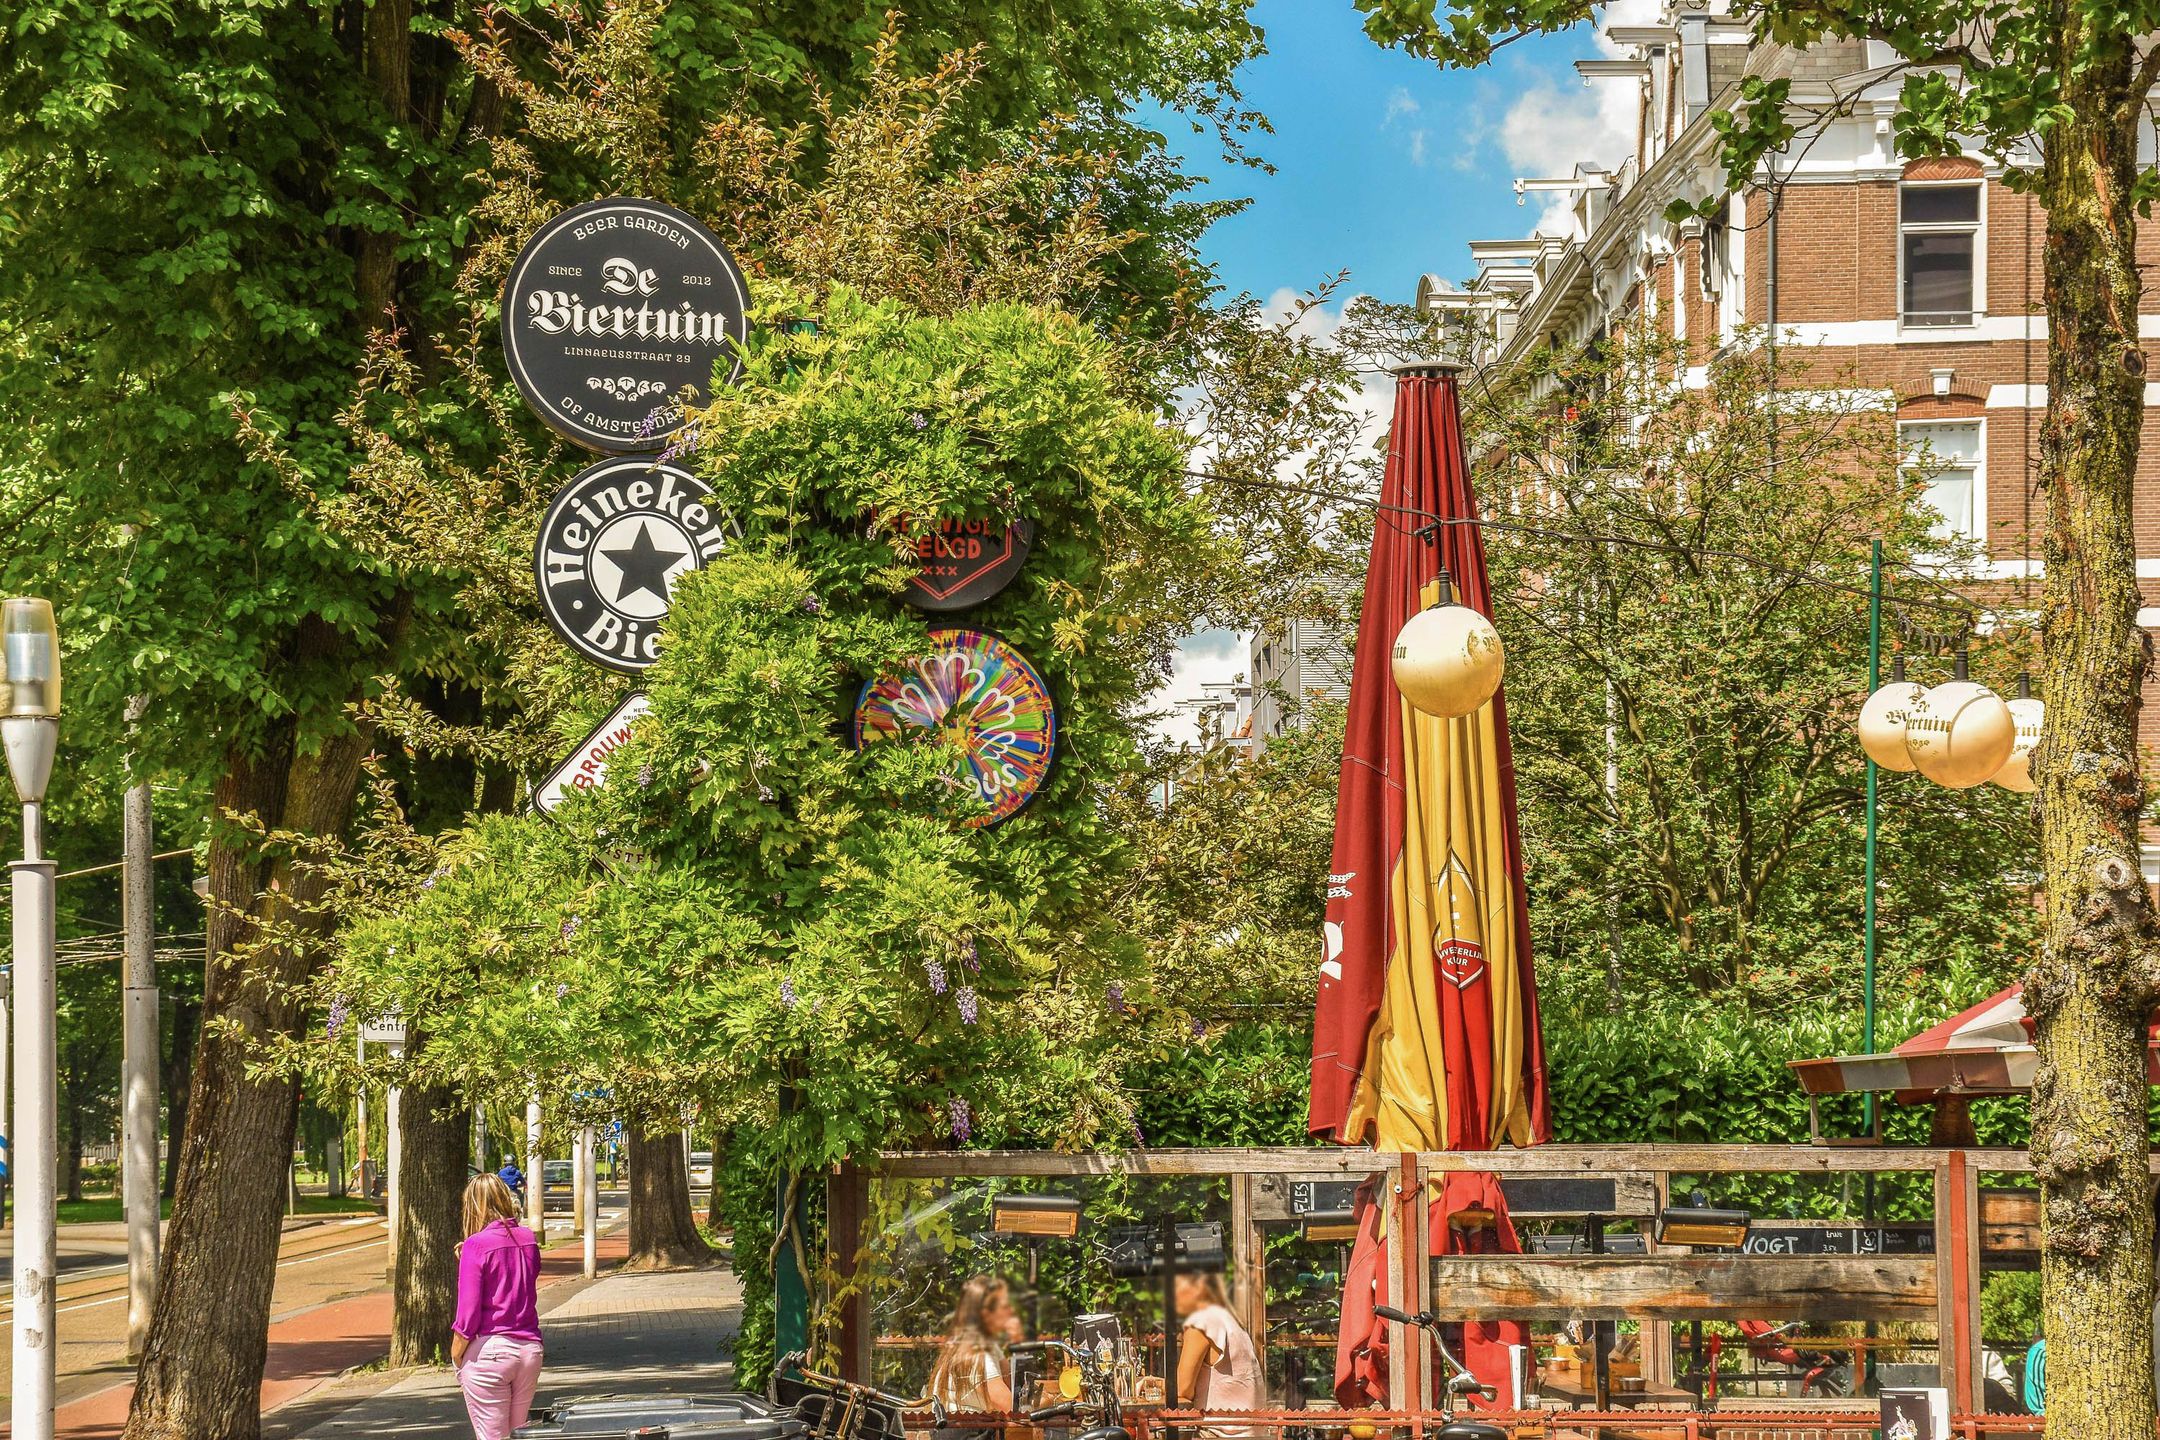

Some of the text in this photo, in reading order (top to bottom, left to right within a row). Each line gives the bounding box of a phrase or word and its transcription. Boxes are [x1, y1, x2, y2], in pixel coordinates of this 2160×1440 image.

[572, 215, 690, 250] BEER GARDEN
[548, 265, 712, 286] SINCE 2012
[601, 257, 660, 298] De
[527, 289, 729, 347] Biertuin
[564, 346, 691, 363] LINNAEUSSTRAAT 29
[560, 396, 583, 416] OF
[547, 473, 725, 587] Heineken
